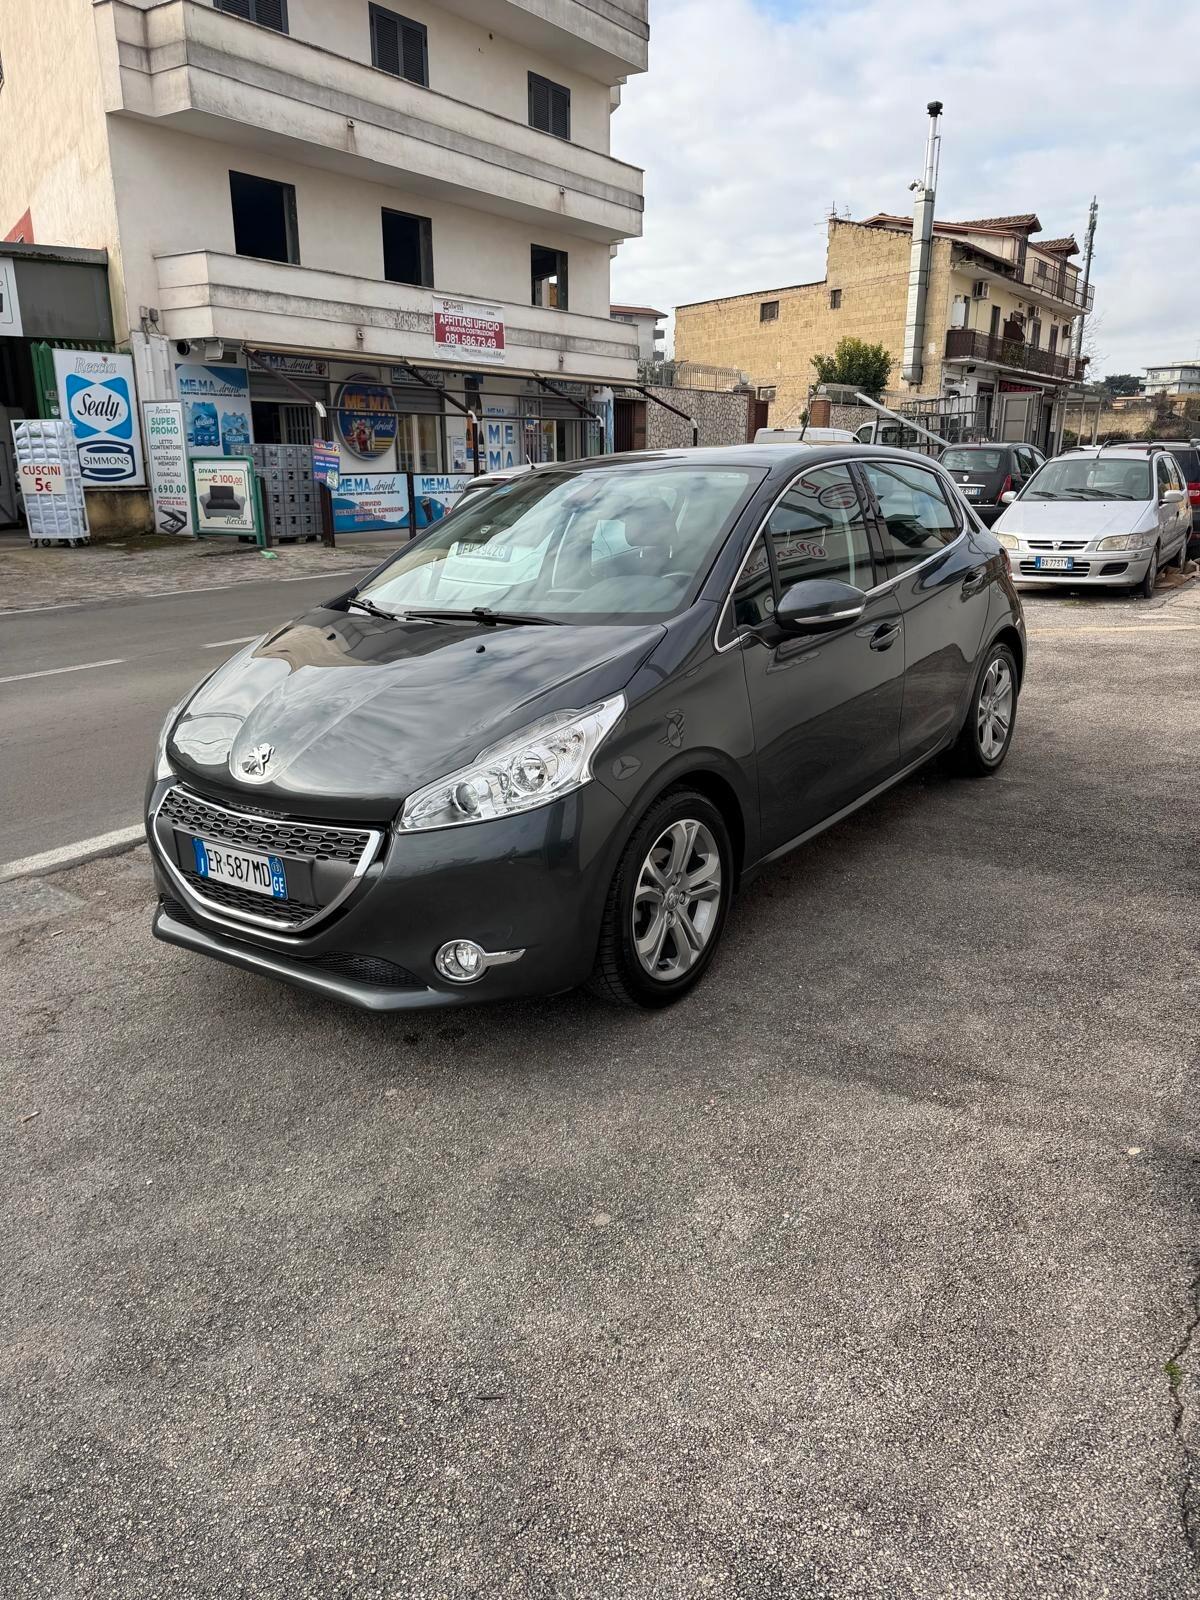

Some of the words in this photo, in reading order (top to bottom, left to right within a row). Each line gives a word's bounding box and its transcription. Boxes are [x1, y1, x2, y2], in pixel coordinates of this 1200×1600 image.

[440, 315, 473, 327] AFFITTASI
[474, 318, 499, 331] UFFICIO
[77, 393, 120, 421] Sealy
[151, 417, 176, 426] SUPER
[151, 426, 179, 435] PROMO
[84, 456, 130, 466] SIMMONS
[22, 465, 61, 476] CUSCINI
